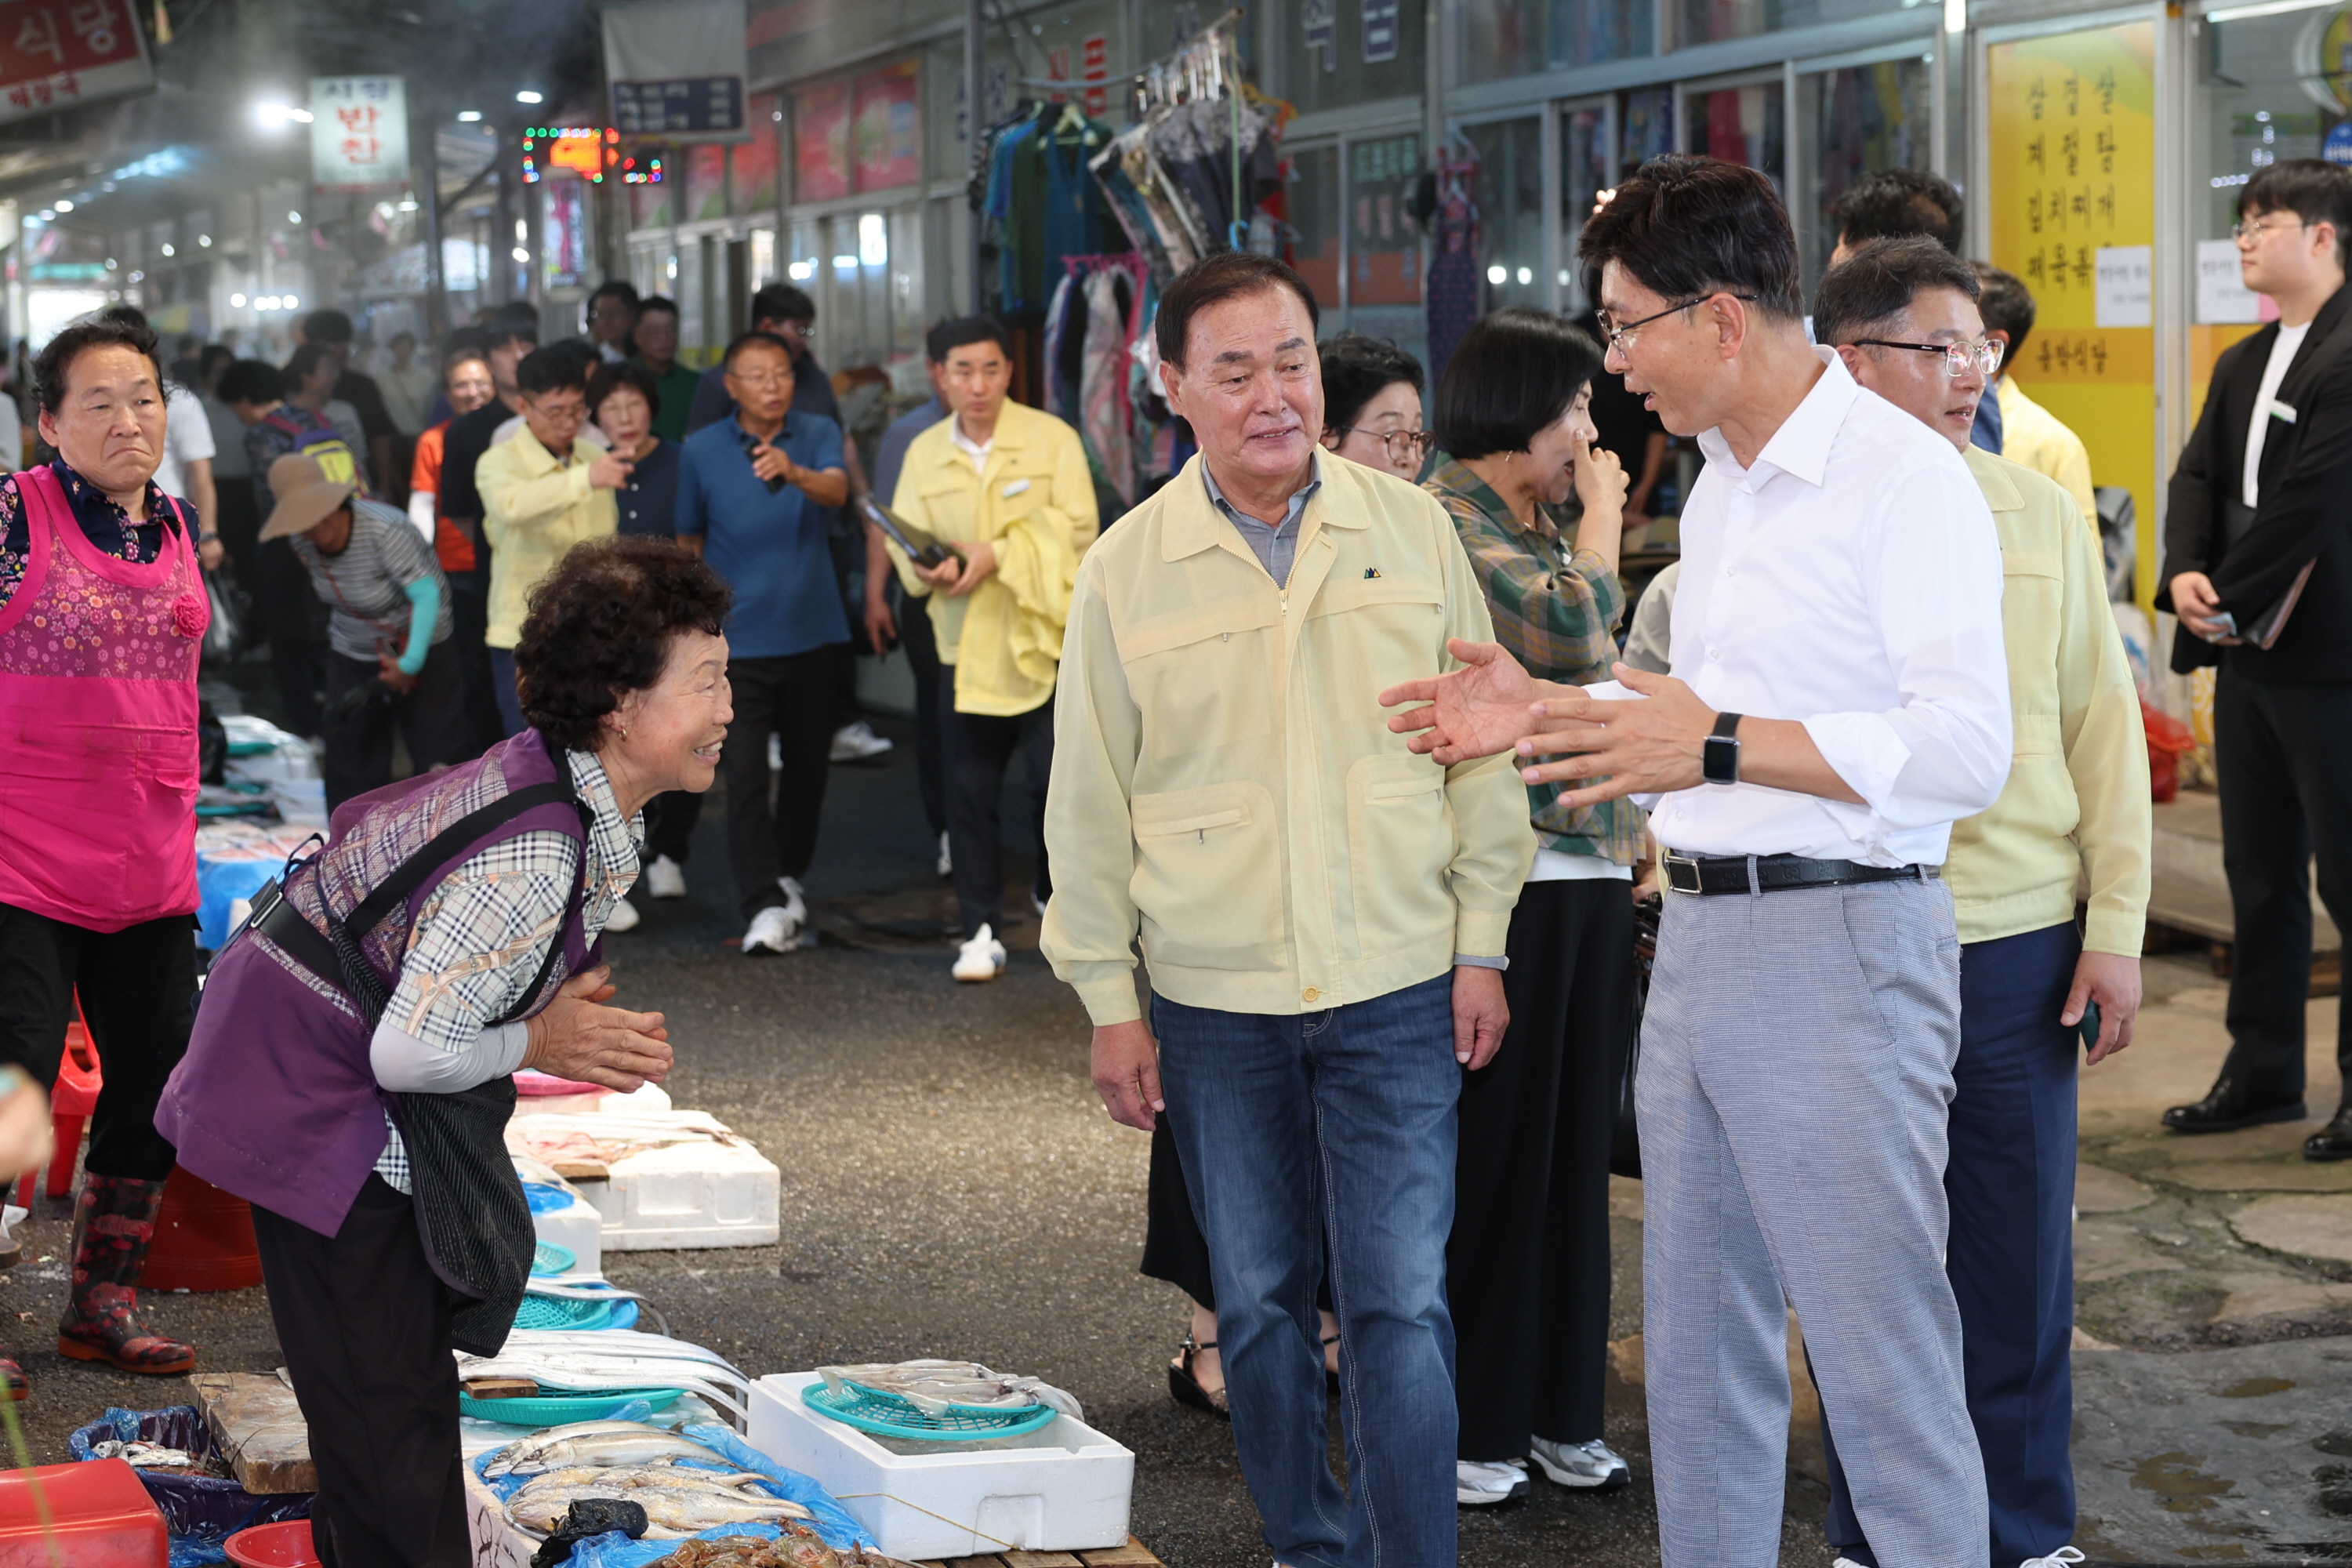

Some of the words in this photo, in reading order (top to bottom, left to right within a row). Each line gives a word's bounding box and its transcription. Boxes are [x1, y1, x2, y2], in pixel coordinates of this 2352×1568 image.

[0, 0, 120, 65] 식당
[335, 104, 384, 165] 반찬
[2027, 183, 2115, 233] 김치찌개
[2027, 242, 2112, 291] 제육볶
